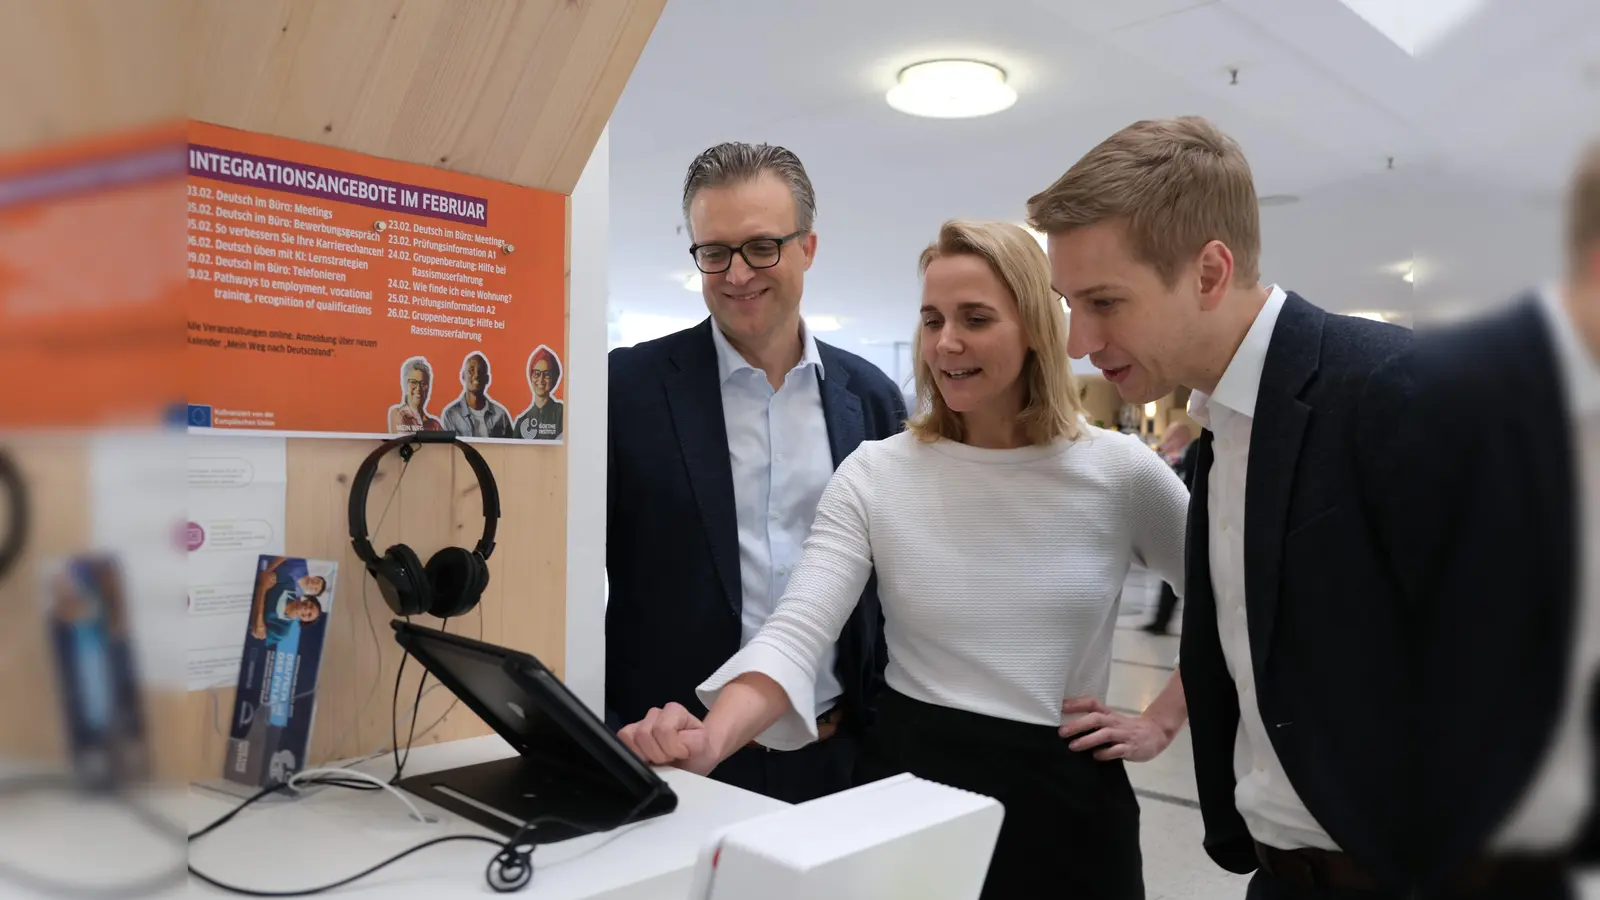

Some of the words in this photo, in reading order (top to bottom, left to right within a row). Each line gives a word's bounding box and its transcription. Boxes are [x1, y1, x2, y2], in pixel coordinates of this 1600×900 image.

[190, 149, 397, 205] INTEGRATIONSANGEBOTE
[401, 189, 419, 209] IM
[422, 193, 485, 220] FEBRUAR
[216, 190, 253, 206] Deutsch
[255, 196, 266, 208] im
[269, 199, 292, 212] Büro:
[294, 204, 333, 219] Meetings
[215, 206, 252, 221] Deutsch
[254, 212, 266, 224] im
[268, 215, 292, 228] Büro:
[294, 219, 380, 241] Bewerbungsgespräch
[388, 220, 412, 232] 23.02.
[413, 224, 443, 237] Deutsch
[444, 228, 454, 239] im
[455, 230, 474, 242] Büro:
[475, 234, 505, 248] Meetings
[215, 222, 227, 234] So
[229, 226, 280, 242] verbessern
[281, 233, 295, 244] Sie
[297, 235, 315, 247] Ihre
[316, 238, 384, 257] Karrierechancen!
[388, 234, 412, 246] 23.02.
[413, 238, 487, 258] Prüfungsinformation
[487, 250, 497, 260] A1
[215, 239, 252, 254] Deutsch
[253, 244, 276, 257] üben
[278, 249, 293, 260] mit
[295, 251, 307, 262] KI:
[308, 252, 369, 270] Lernstrategien
[388, 248, 412, 260] 24.02.
[413, 253, 477, 272] Gruppenberatung:
[478, 262, 495, 273] Hilfe
[495, 264, 507, 275] bei
[215, 255, 252, 270] Deutsch
[254, 260, 265, 272] im
[267, 263, 291, 276] Büro:
[293, 266, 346, 282] Telefonieren
[412, 267, 484, 287] Rassismuserfahrung
[213, 271, 259, 289] Pathways
[261, 278, 270, 289] to
[271, 279, 328, 296] employment,
[330, 287, 373, 301] vocational
[387, 278, 411, 290] 24.02.
[412, 281, 428, 292] Wie
[429, 283, 448, 295] finde
[449, 286, 460, 297] ich
[460, 288, 476, 299] eine
[476, 290, 512, 304] Wohnung?
[214, 288, 253, 304] training,
[254, 293, 304, 308] recognition
[305, 298, 315, 309] of
[316, 299, 372, 315] qualifications
[387, 293, 411, 305] 25.02.
[412, 296, 485, 314] Prüfungsinformation
[486, 305, 496, 315] A2
[387, 307, 411, 320] 26.02.
[411, 310, 476, 328] Gruppenberatung:
[476, 317, 493, 328] Hilfe
[494, 319, 505, 329] bei
[249, 342, 266, 353] Weg
[411, 325, 482, 343] Rassismuserfahrung
